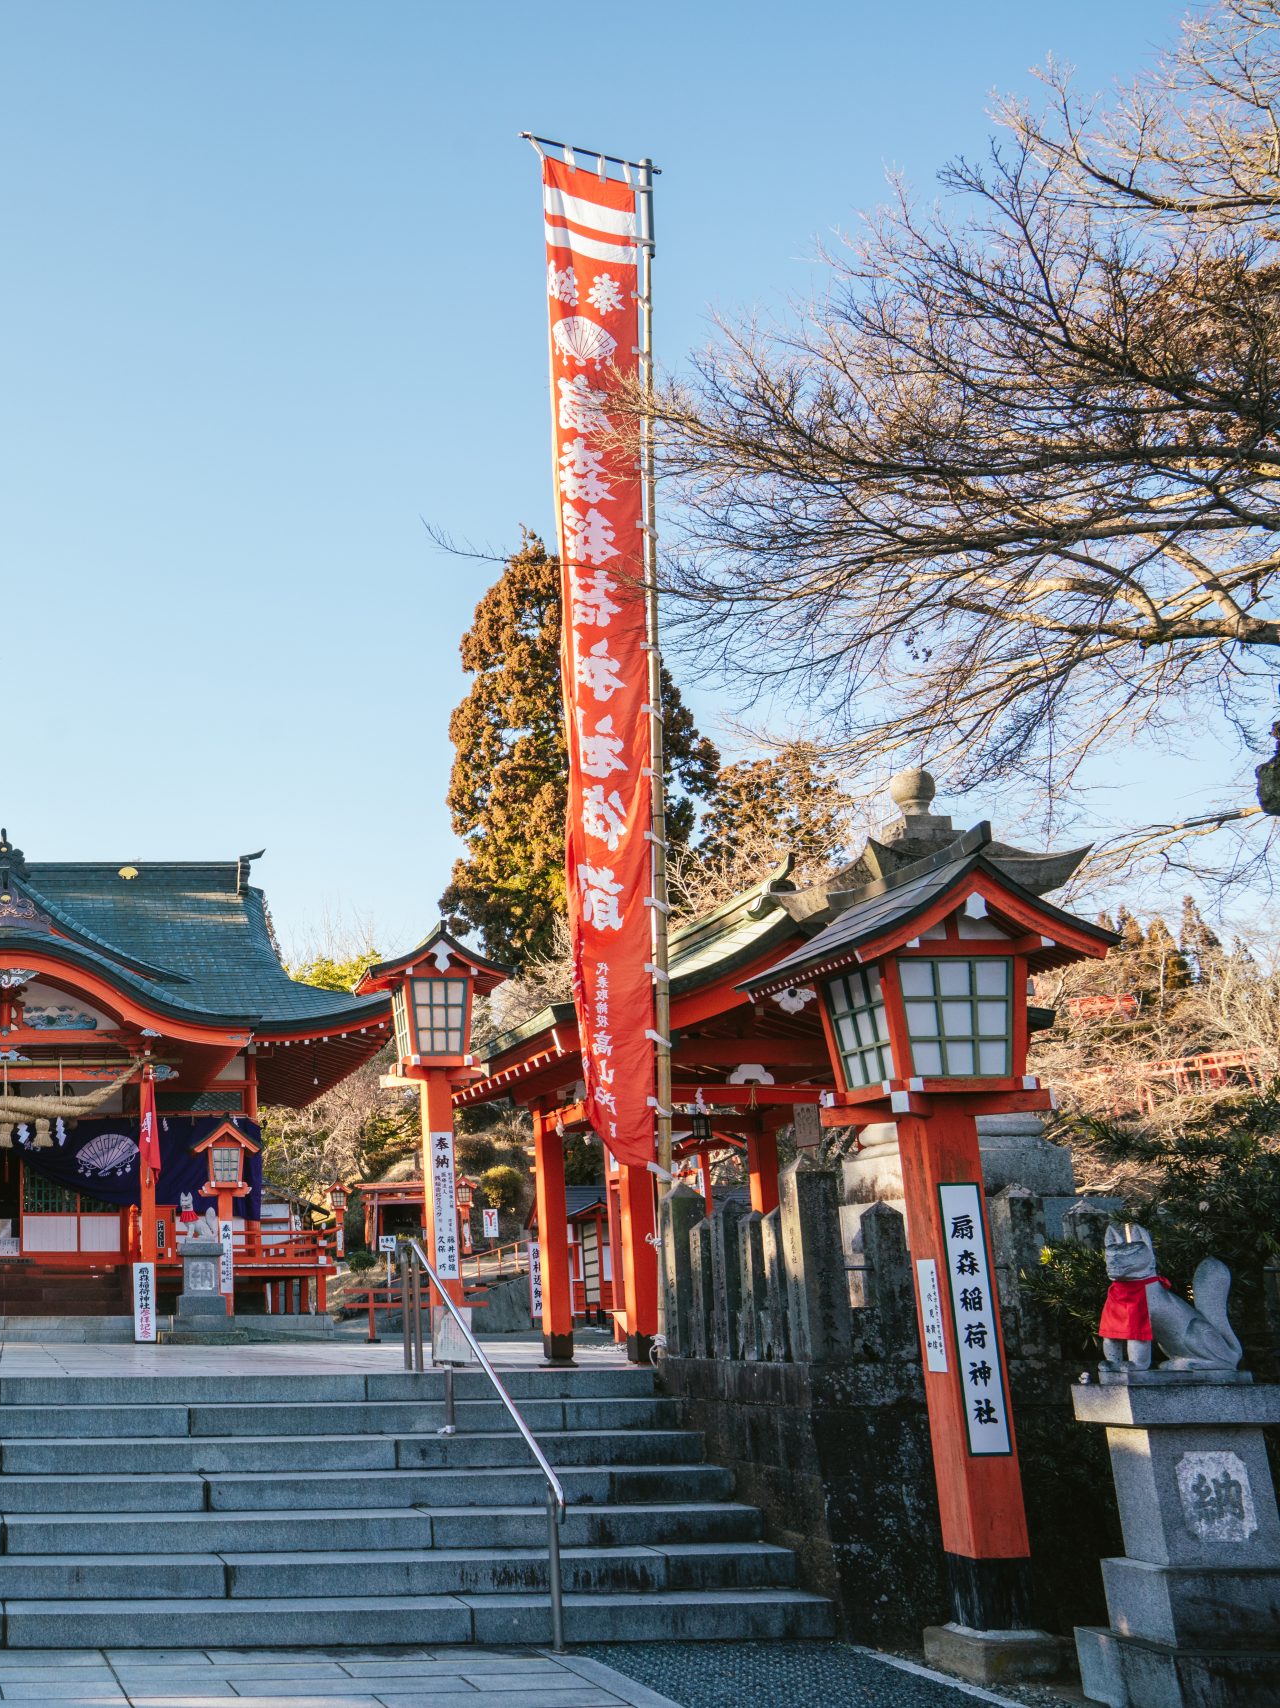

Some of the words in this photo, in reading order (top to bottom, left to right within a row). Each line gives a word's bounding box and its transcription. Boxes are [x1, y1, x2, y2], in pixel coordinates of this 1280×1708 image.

[435, 1137, 450, 1169] 奉納
[950, 1214, 999, 1426] 扇森稲荷神社
[1191, 1469, 1245, 1522] 納
